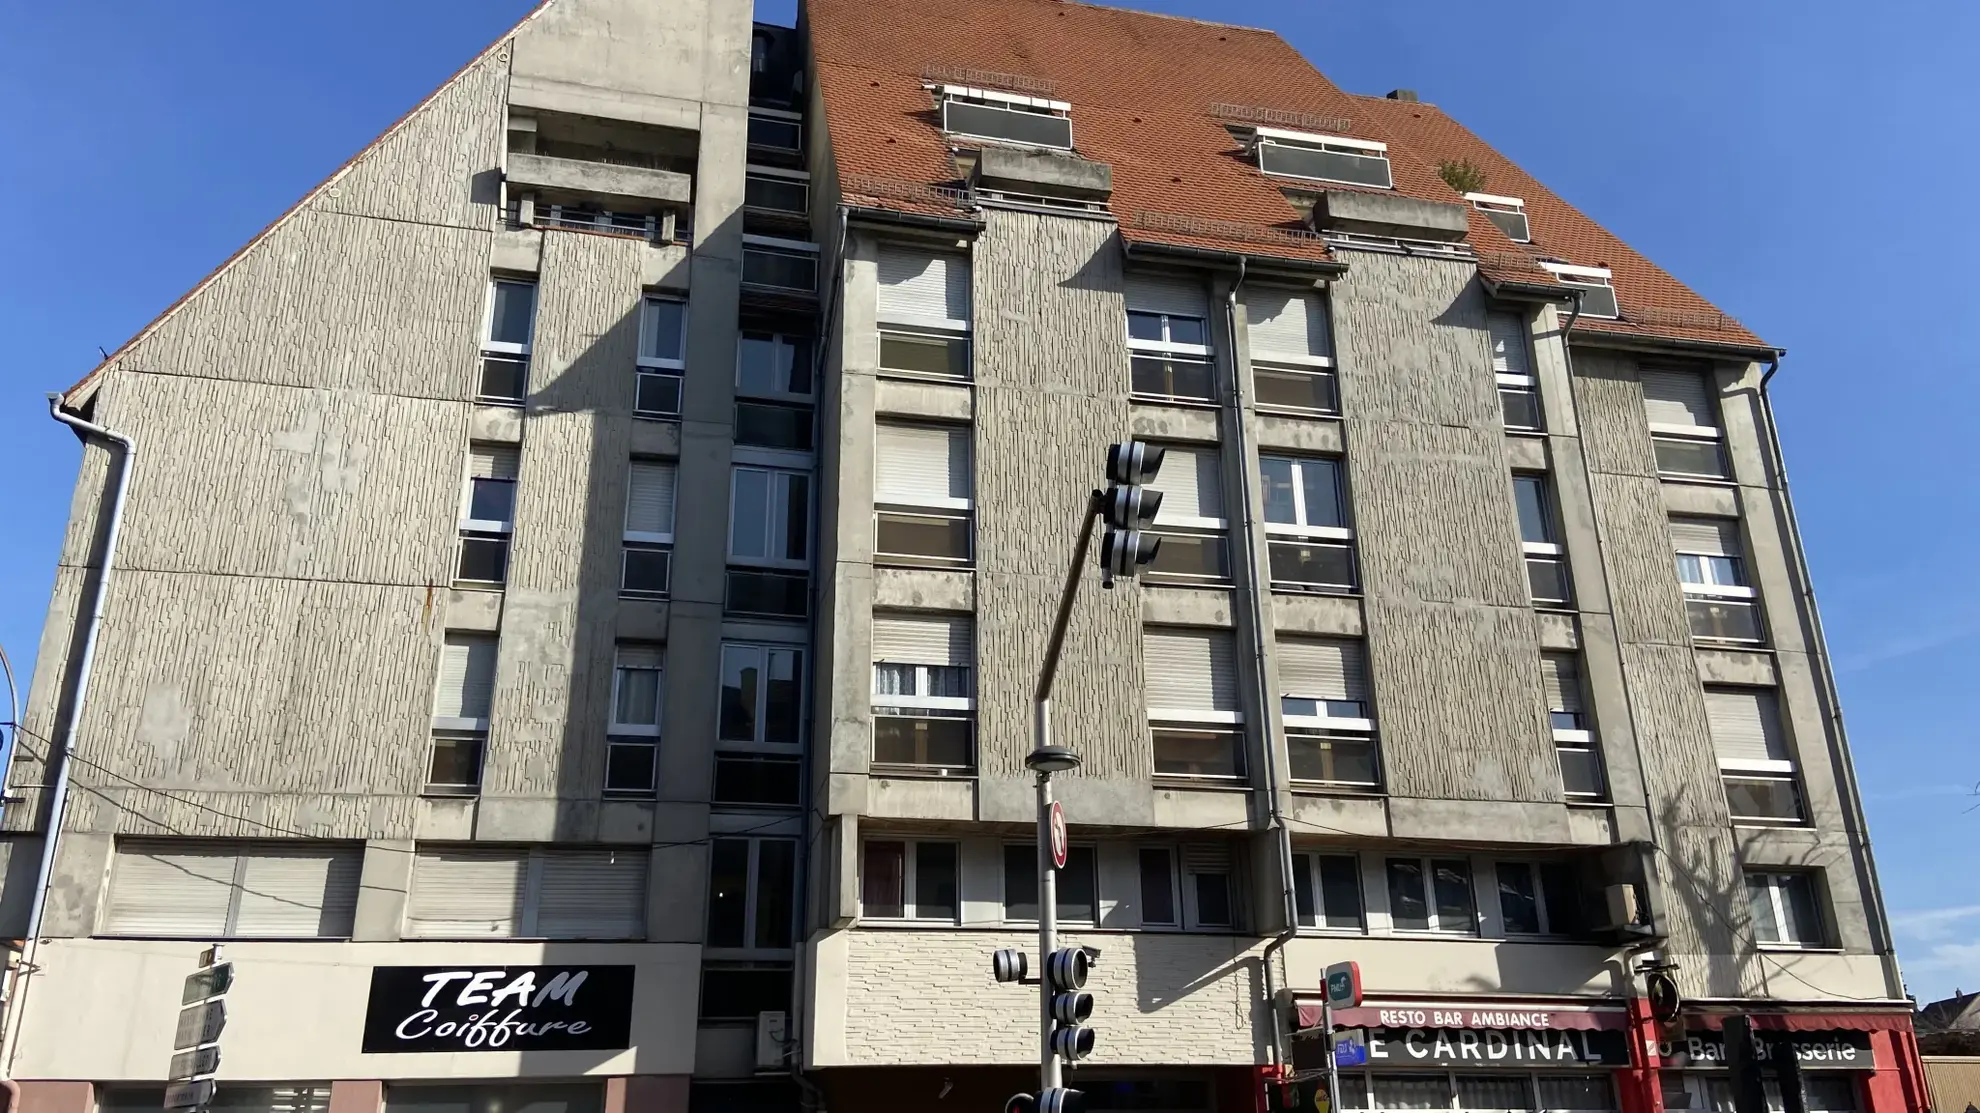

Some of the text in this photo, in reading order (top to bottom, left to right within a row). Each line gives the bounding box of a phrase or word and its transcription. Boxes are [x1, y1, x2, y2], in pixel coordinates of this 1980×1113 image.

[421, 970, 589, 1008] TEAM
[395, 1008, 592, 1047] Coiffure
[1380, 1010, 1550, 1027] RESTO BAR AMBIANCE
[1368, 1029, 1602, 1060] E CARDINAL
[1688, 1036, 1856, 1061] Bar Brsserie
